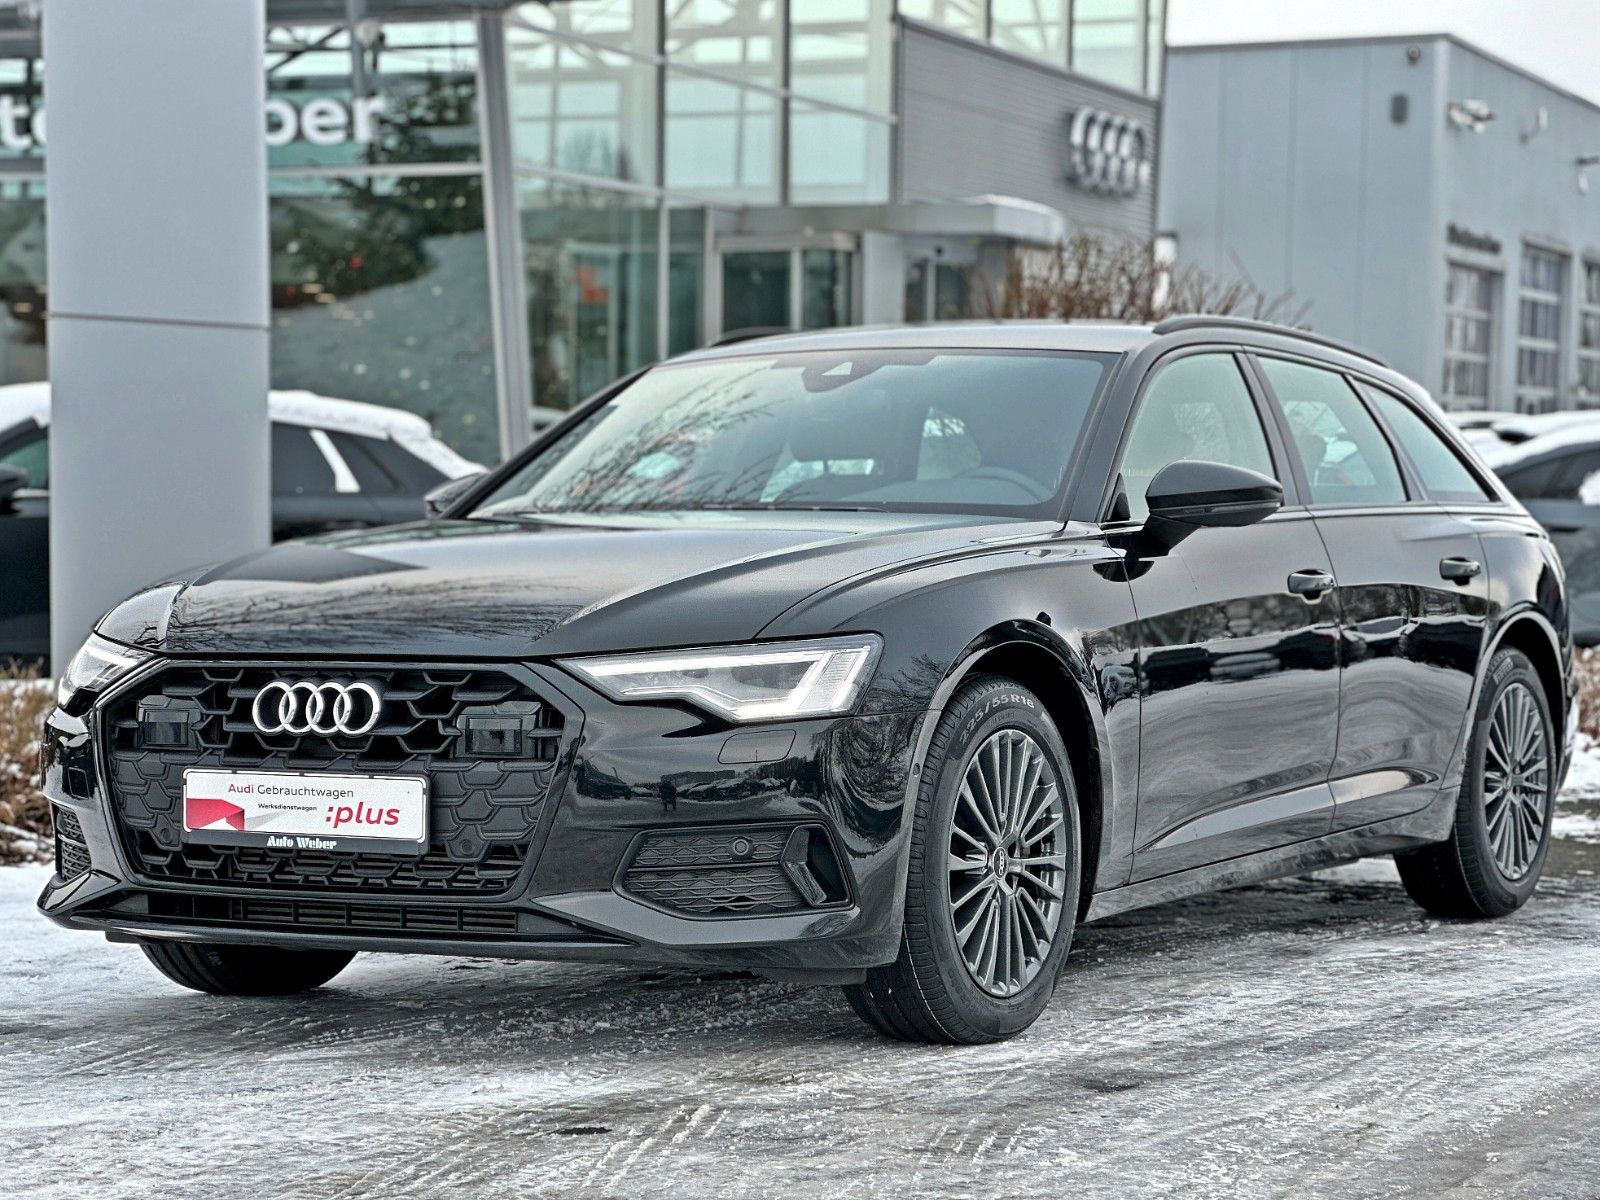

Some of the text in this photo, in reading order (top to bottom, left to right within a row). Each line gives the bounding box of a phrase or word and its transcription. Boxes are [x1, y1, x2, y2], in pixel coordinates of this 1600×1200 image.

[227, 783, 354, 799] Audi Gebrauchtwagen
[257, 803, 318, 812] Werksdienstwagen
[325, 801, 400, 829] :plus
[266, 835, 337, 850] Auto Weber
